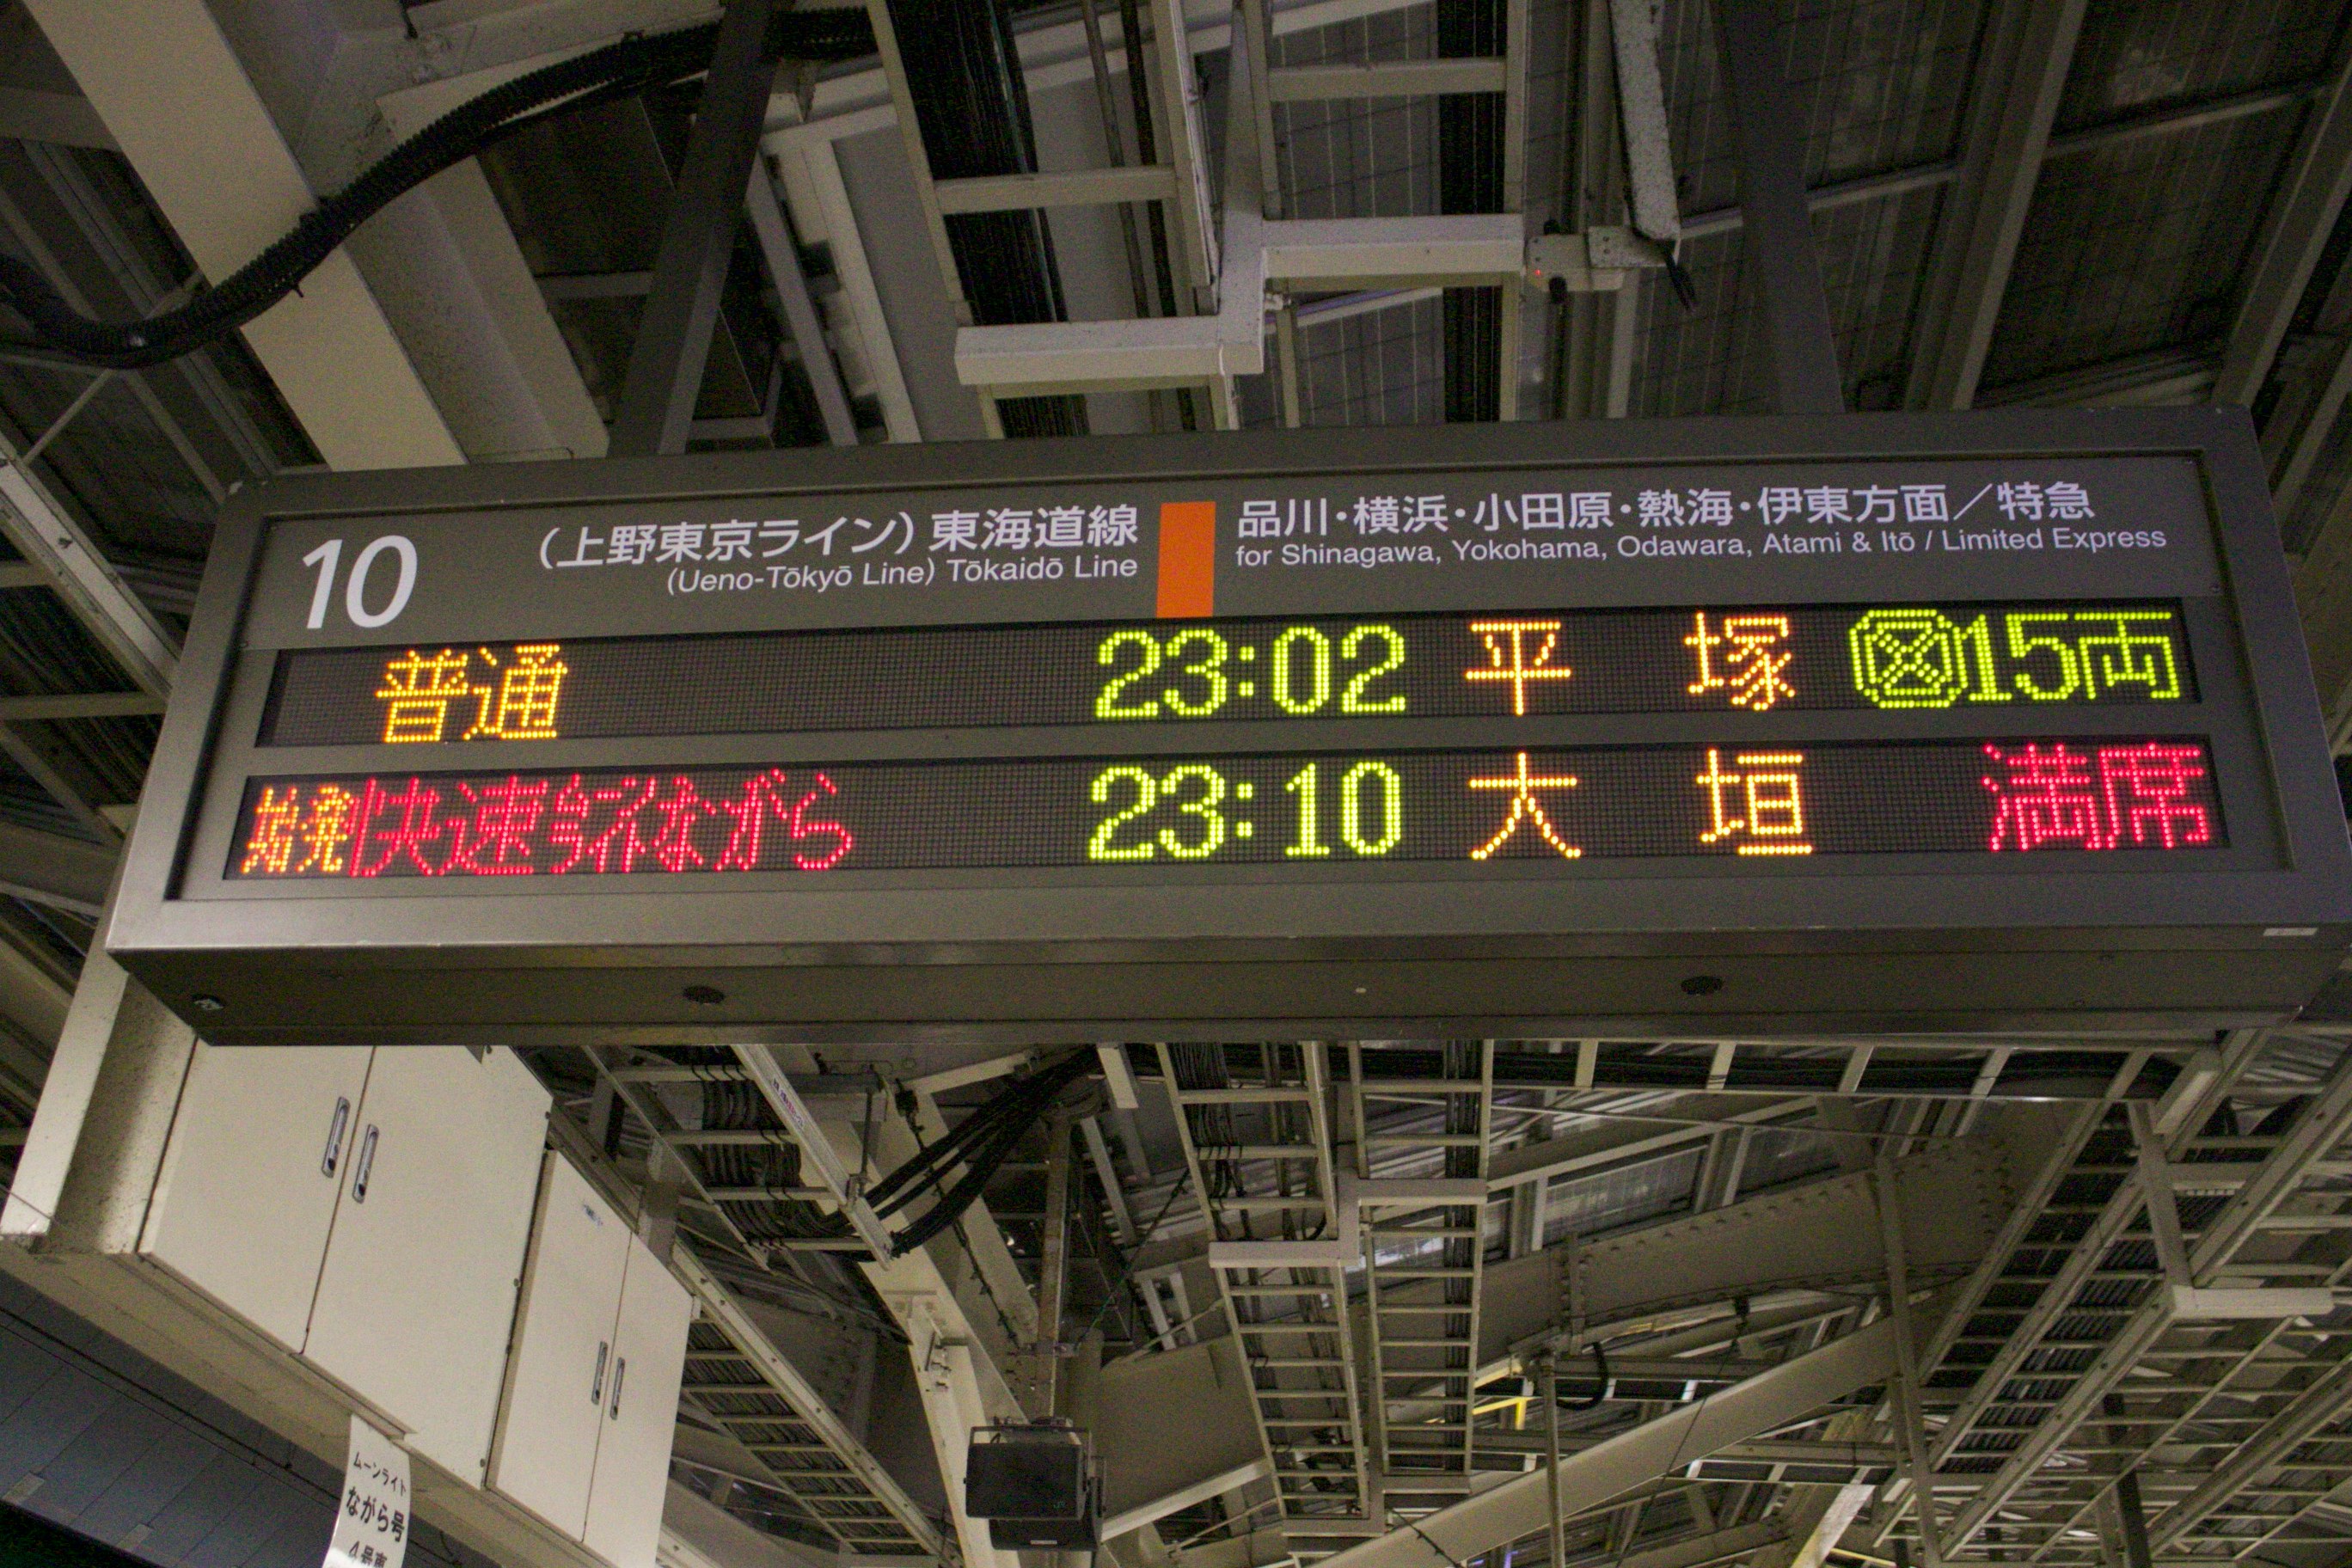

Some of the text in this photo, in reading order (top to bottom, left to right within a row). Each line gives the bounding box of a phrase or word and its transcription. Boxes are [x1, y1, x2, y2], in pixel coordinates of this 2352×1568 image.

[863, 558, 935, 586] Line)
[946, 558, 1064, 583] Tōkaidō
[1075, 555, 1138, 579] Line
[1236, 528, 2167, 568] for Shinagawa, Yokohama, Odawara, Atami & Itō / Limited Express
[303, 535, 419, 630] 10
[375, 644, 569, 744] 普通
[1096, 625, 1407, 719] 23:02
[1088, 762, 1402, 860] 23:10
[1981, 743, 2210, 853] 満席
[353, 1451, 407, 1497] ムーンライト
[346, 1485, 405, 1543] ながら号
